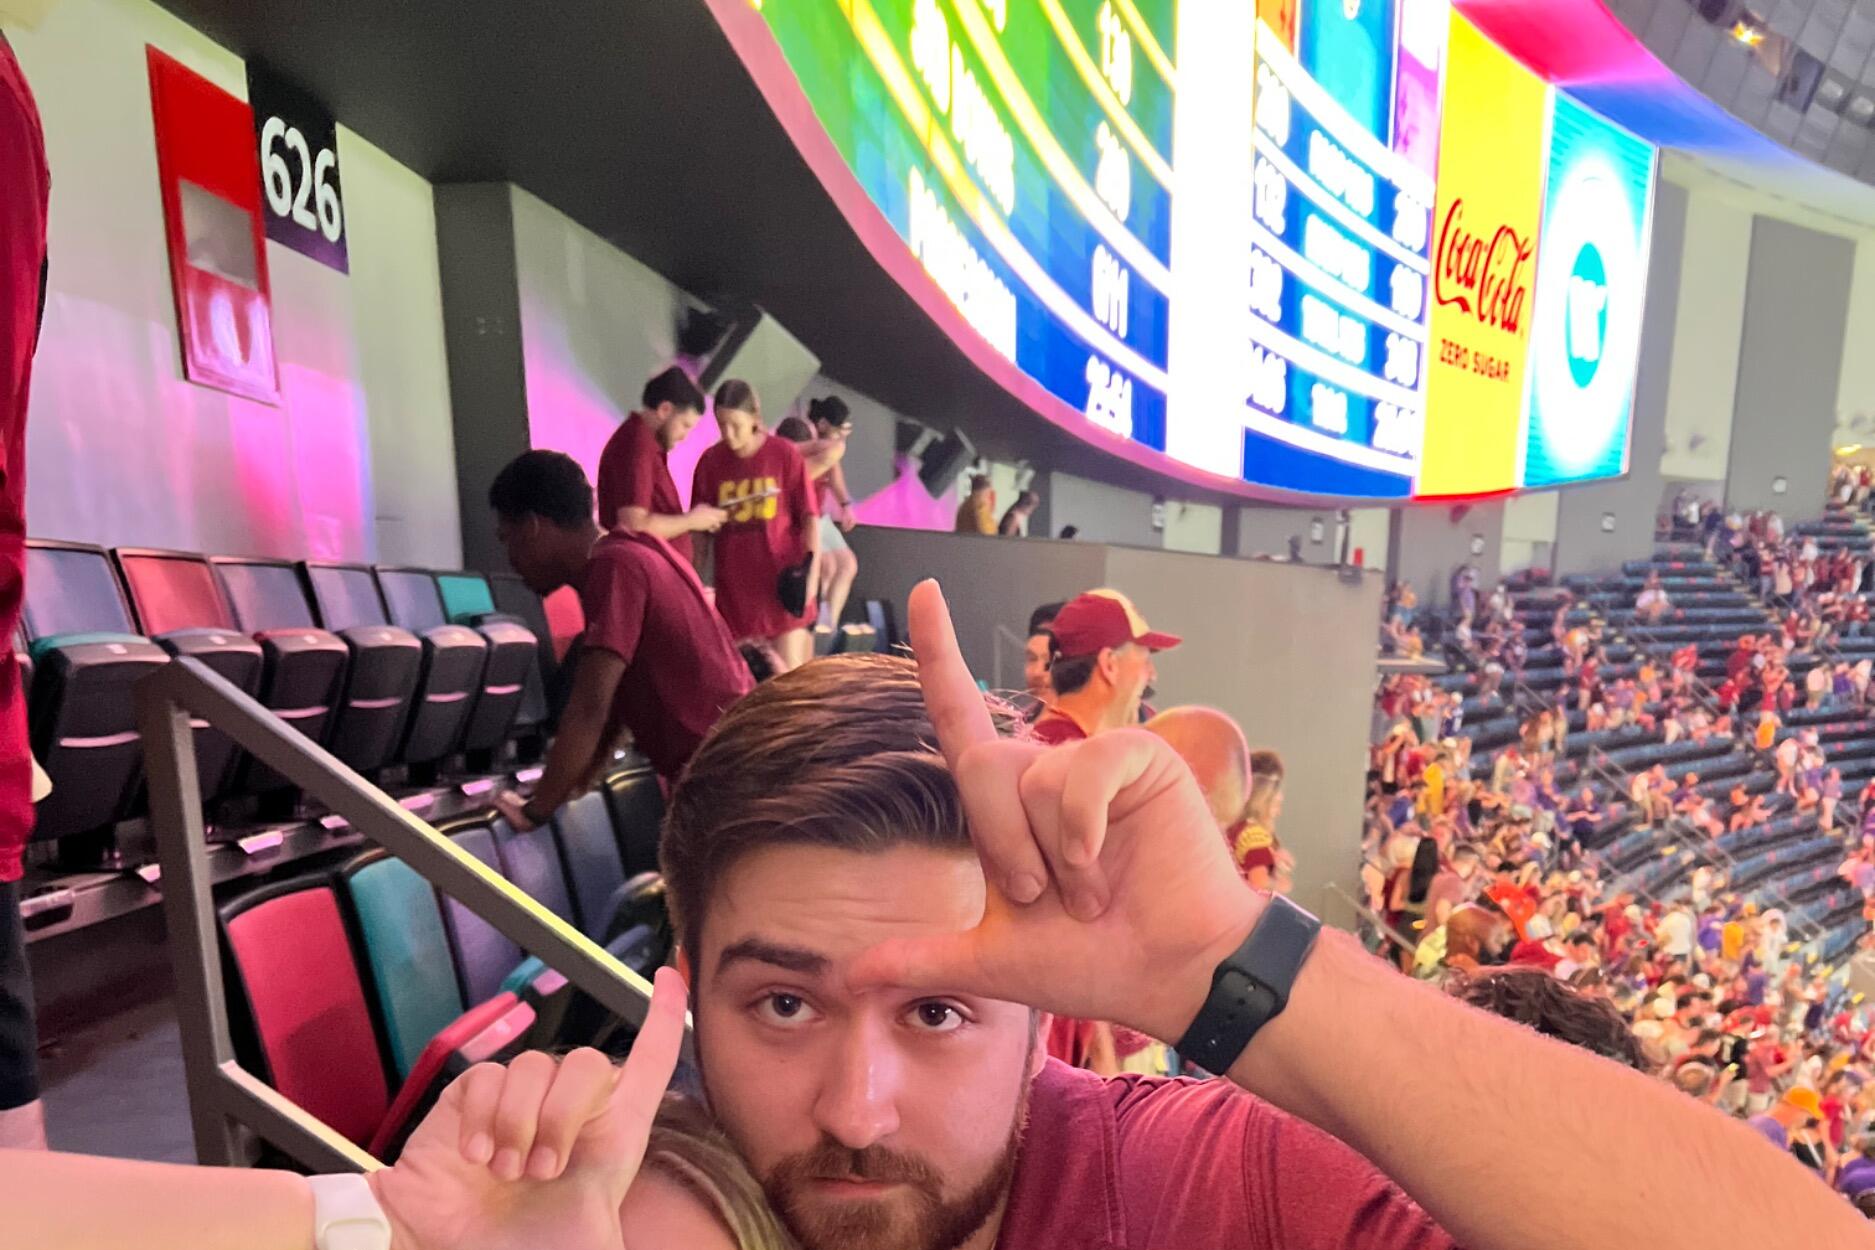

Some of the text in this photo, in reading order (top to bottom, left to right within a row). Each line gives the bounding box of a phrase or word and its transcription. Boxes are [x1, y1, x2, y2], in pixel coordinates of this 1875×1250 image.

[260, 115, 342, 243] 626
[1439, 337, 1470, 371] ZERO
[1471, 350, 1511, 384] SUGAR
